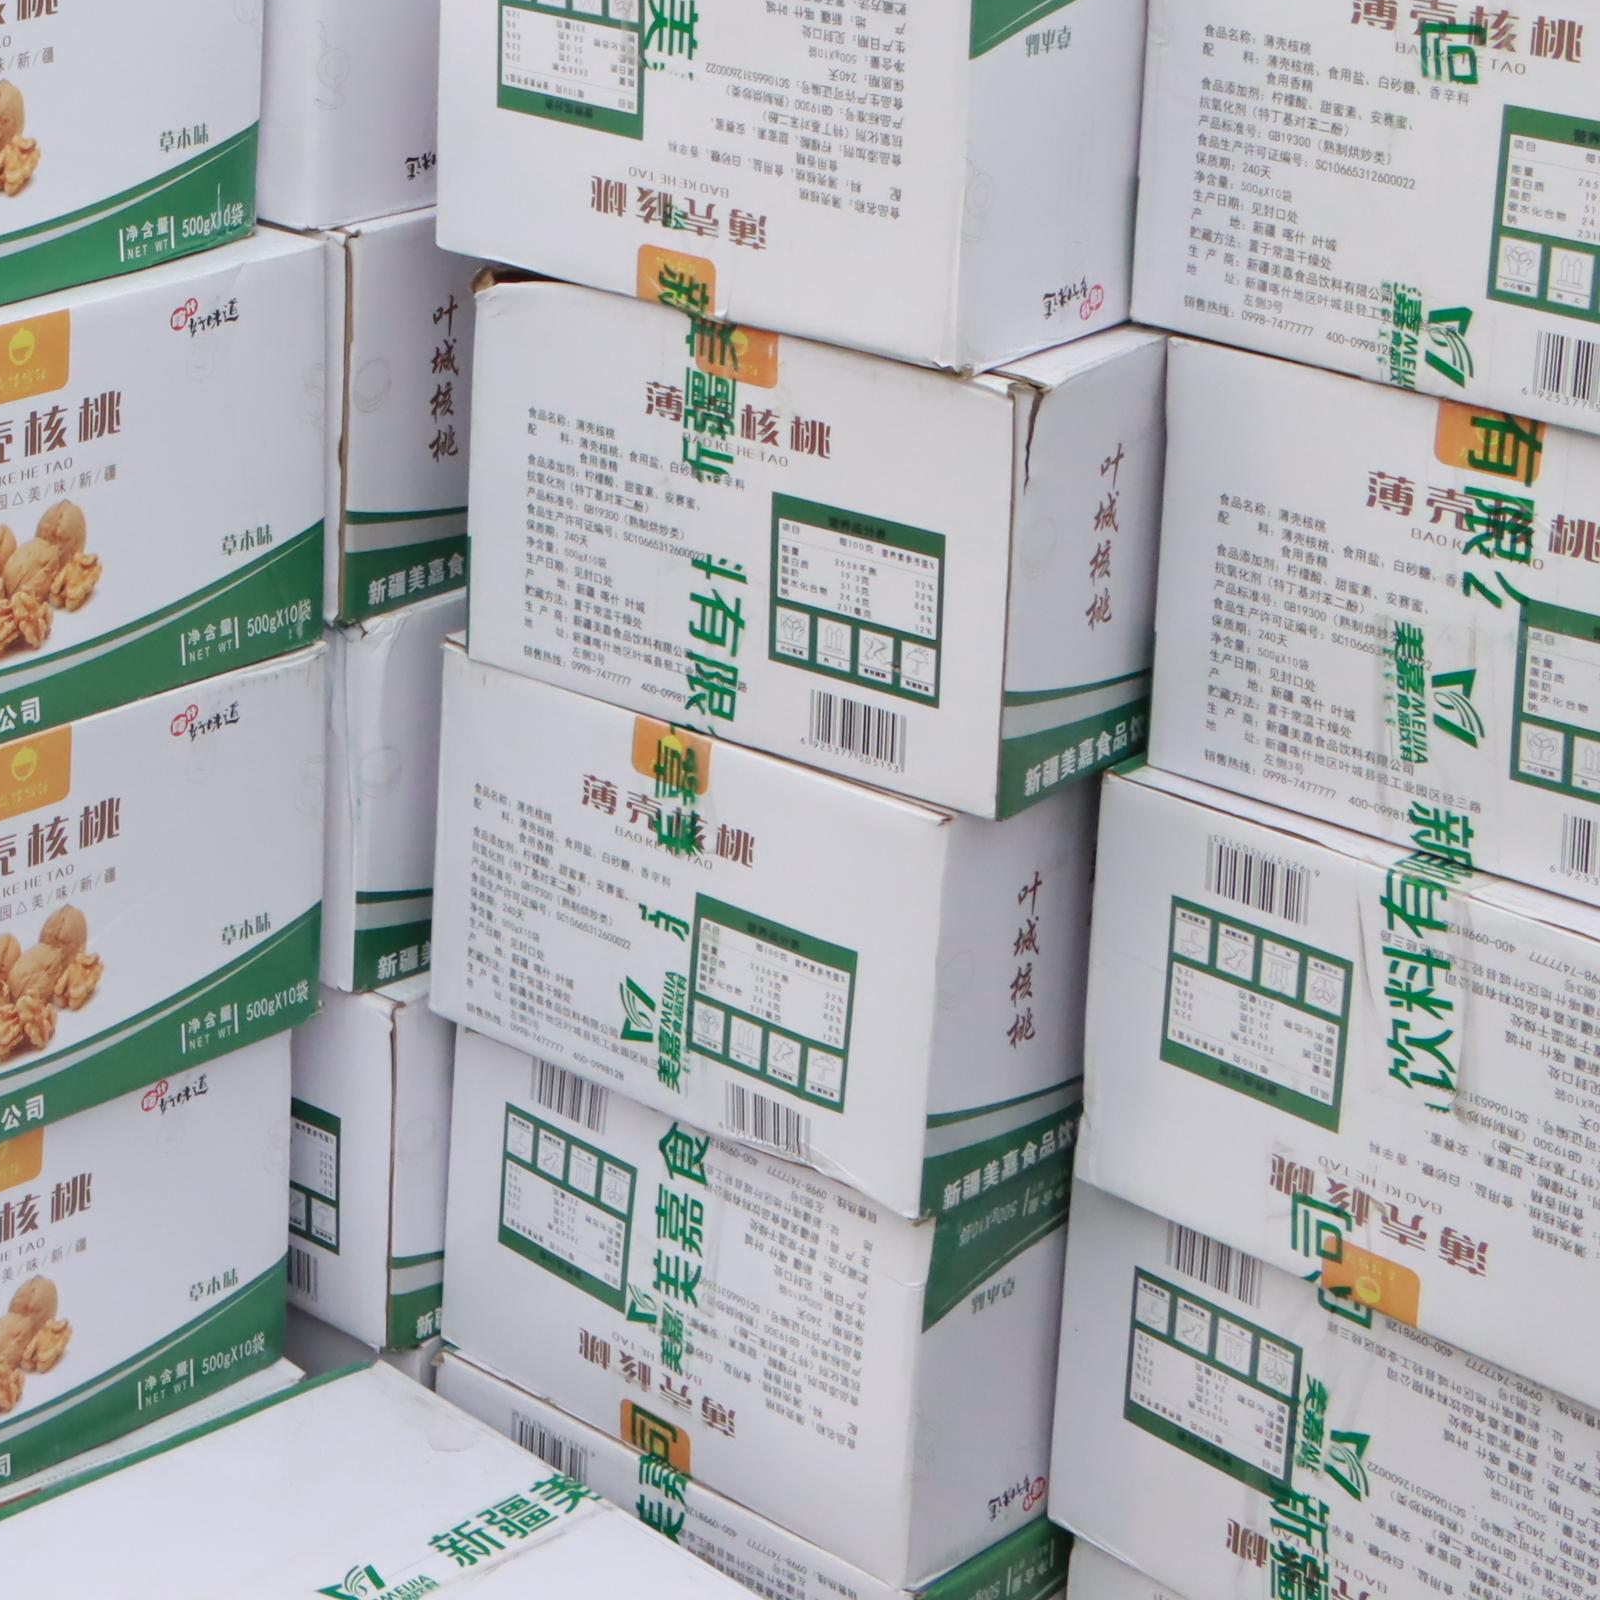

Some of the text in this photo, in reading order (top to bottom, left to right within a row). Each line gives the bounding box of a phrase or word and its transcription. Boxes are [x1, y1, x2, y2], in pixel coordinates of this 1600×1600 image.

[1204, 24, 1313, 56] 食品名称：薄壳核桃
[1266, 71, 1313, 93] 食用香精
[159, 123, 209, 153] 草本味
[1195, 152, 1272, 180] 保质期：240天
[1192, 189, 1298, 225] 生产日期：见封口处
[126, 218, 169, 242] 净含量
[1312, 234, 1337, 253] 叶城
[127, 239, 168, 259] NET WT
[1189, 225, 1332, 272] 贮藏方法：置于常温干燥处
[430, 296, 462, 464] 叶城核桃
[20, 470, 40, 485] HE
[44, 457, 73, 477] TAO
[1219, 493, 1327, 534] 食品名称：薄壳核桃
[220, 525, 272, 557] 草本味
[1085, 443, 1125, 632] 叶城核桃
[187, 618, 233, 645] 净含量
[188, 640, 232, 663] NET WT
[2, 886, 20, 902] KE
[23, 876, 43, 891] HE
[48, 864, 75, 885] TAO
[220, 913, 272, 946] 草本味
[1006, 869, 1044, 1050] 叶城核桃
[188, 1004, 234, 1034] 净含量
[189, 1025, 233, 1050] NET WT
[17, 1238, 46, 1261] TAO
[189, 1268, 239, 1302] 草本味
[144, 1360, 189, 1390] 净含量
[145, 1380, 188, 1406] NET WT
[427, 1473, 603, 1569] 新疆美
